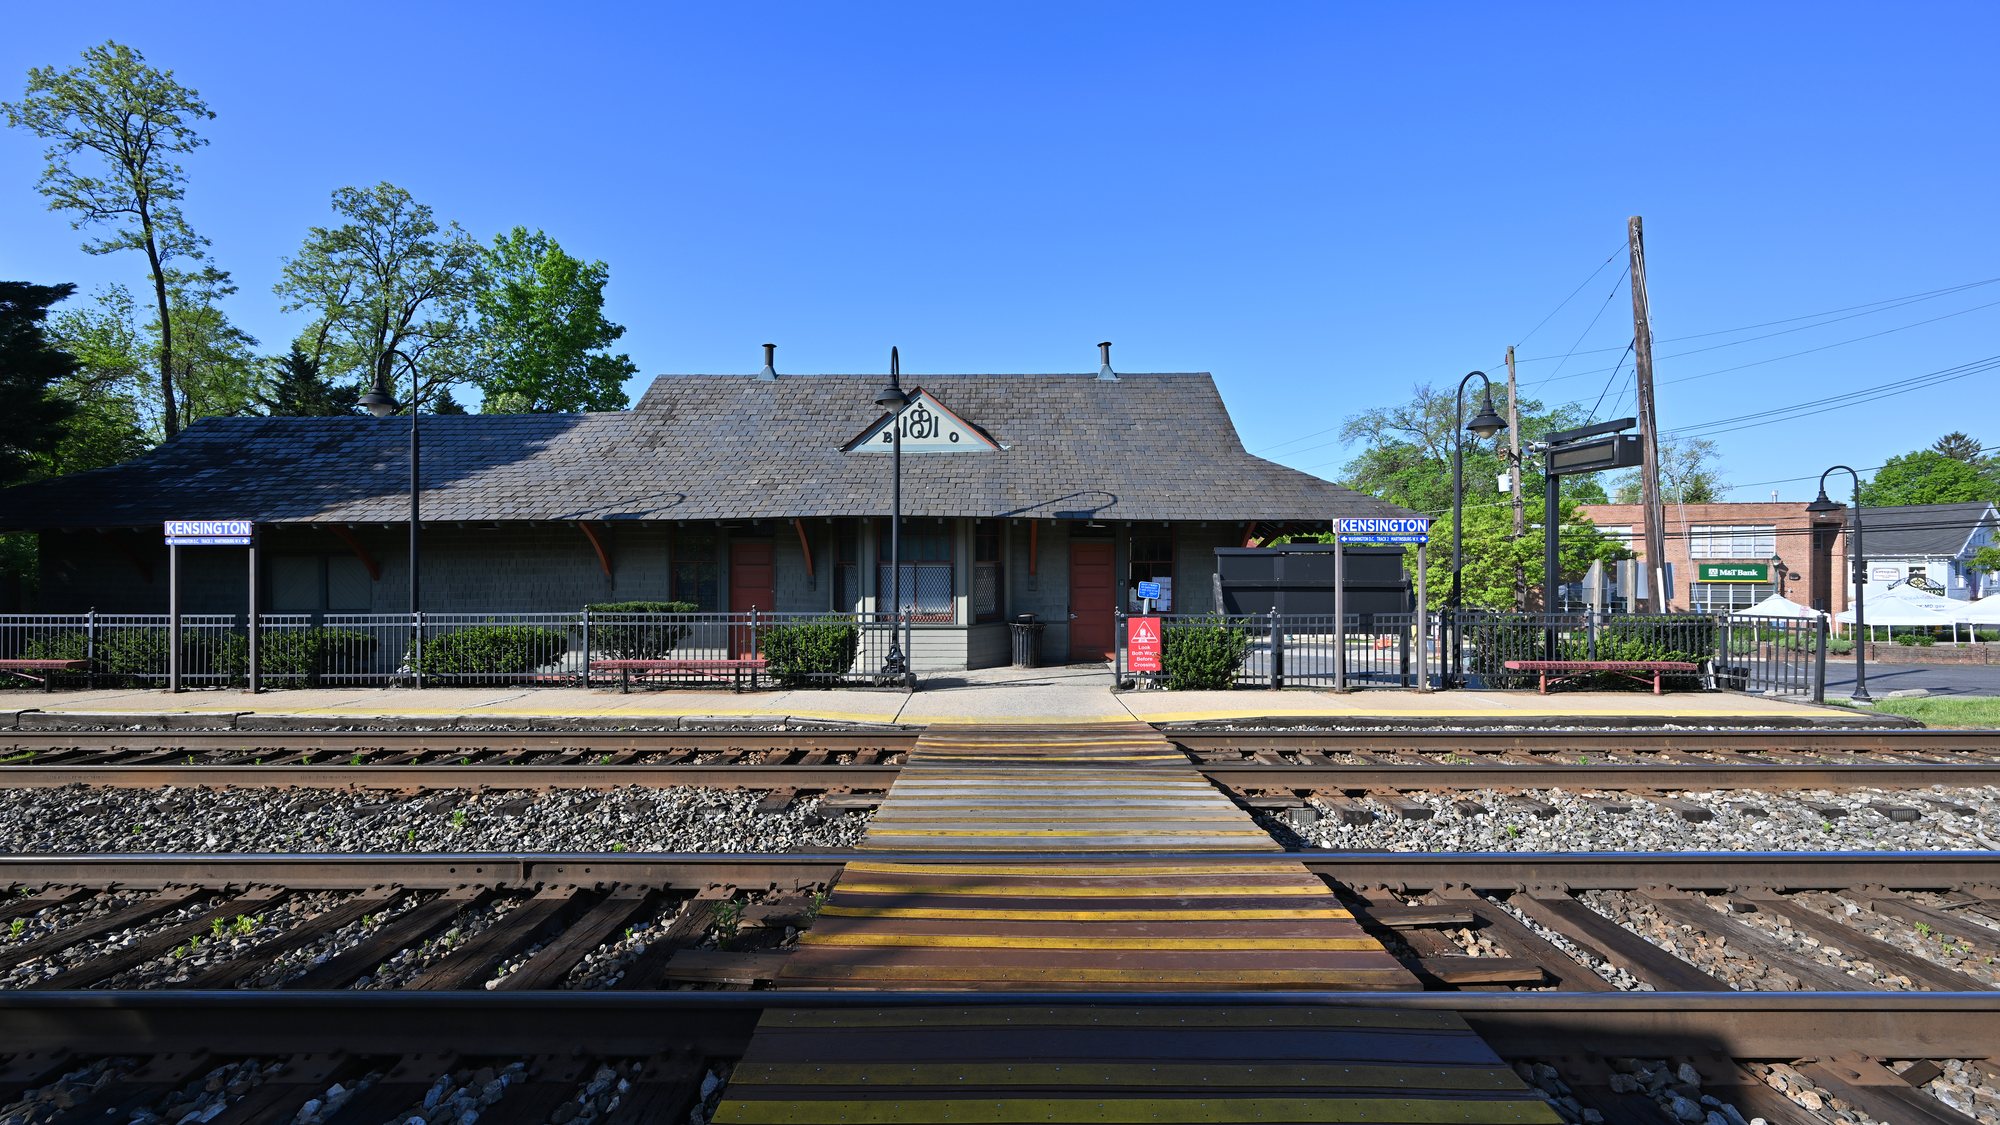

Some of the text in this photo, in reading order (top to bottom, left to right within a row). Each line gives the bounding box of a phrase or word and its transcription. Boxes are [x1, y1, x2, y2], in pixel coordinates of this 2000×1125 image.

[902, 409, 939, 439] 1891
[882, 431, 893, 443] B
[949, 431, 960, 443] O
[167, 522, 249, 534] KENSINGTON
[1340, 519, 1427, 532] KENSINGTON
